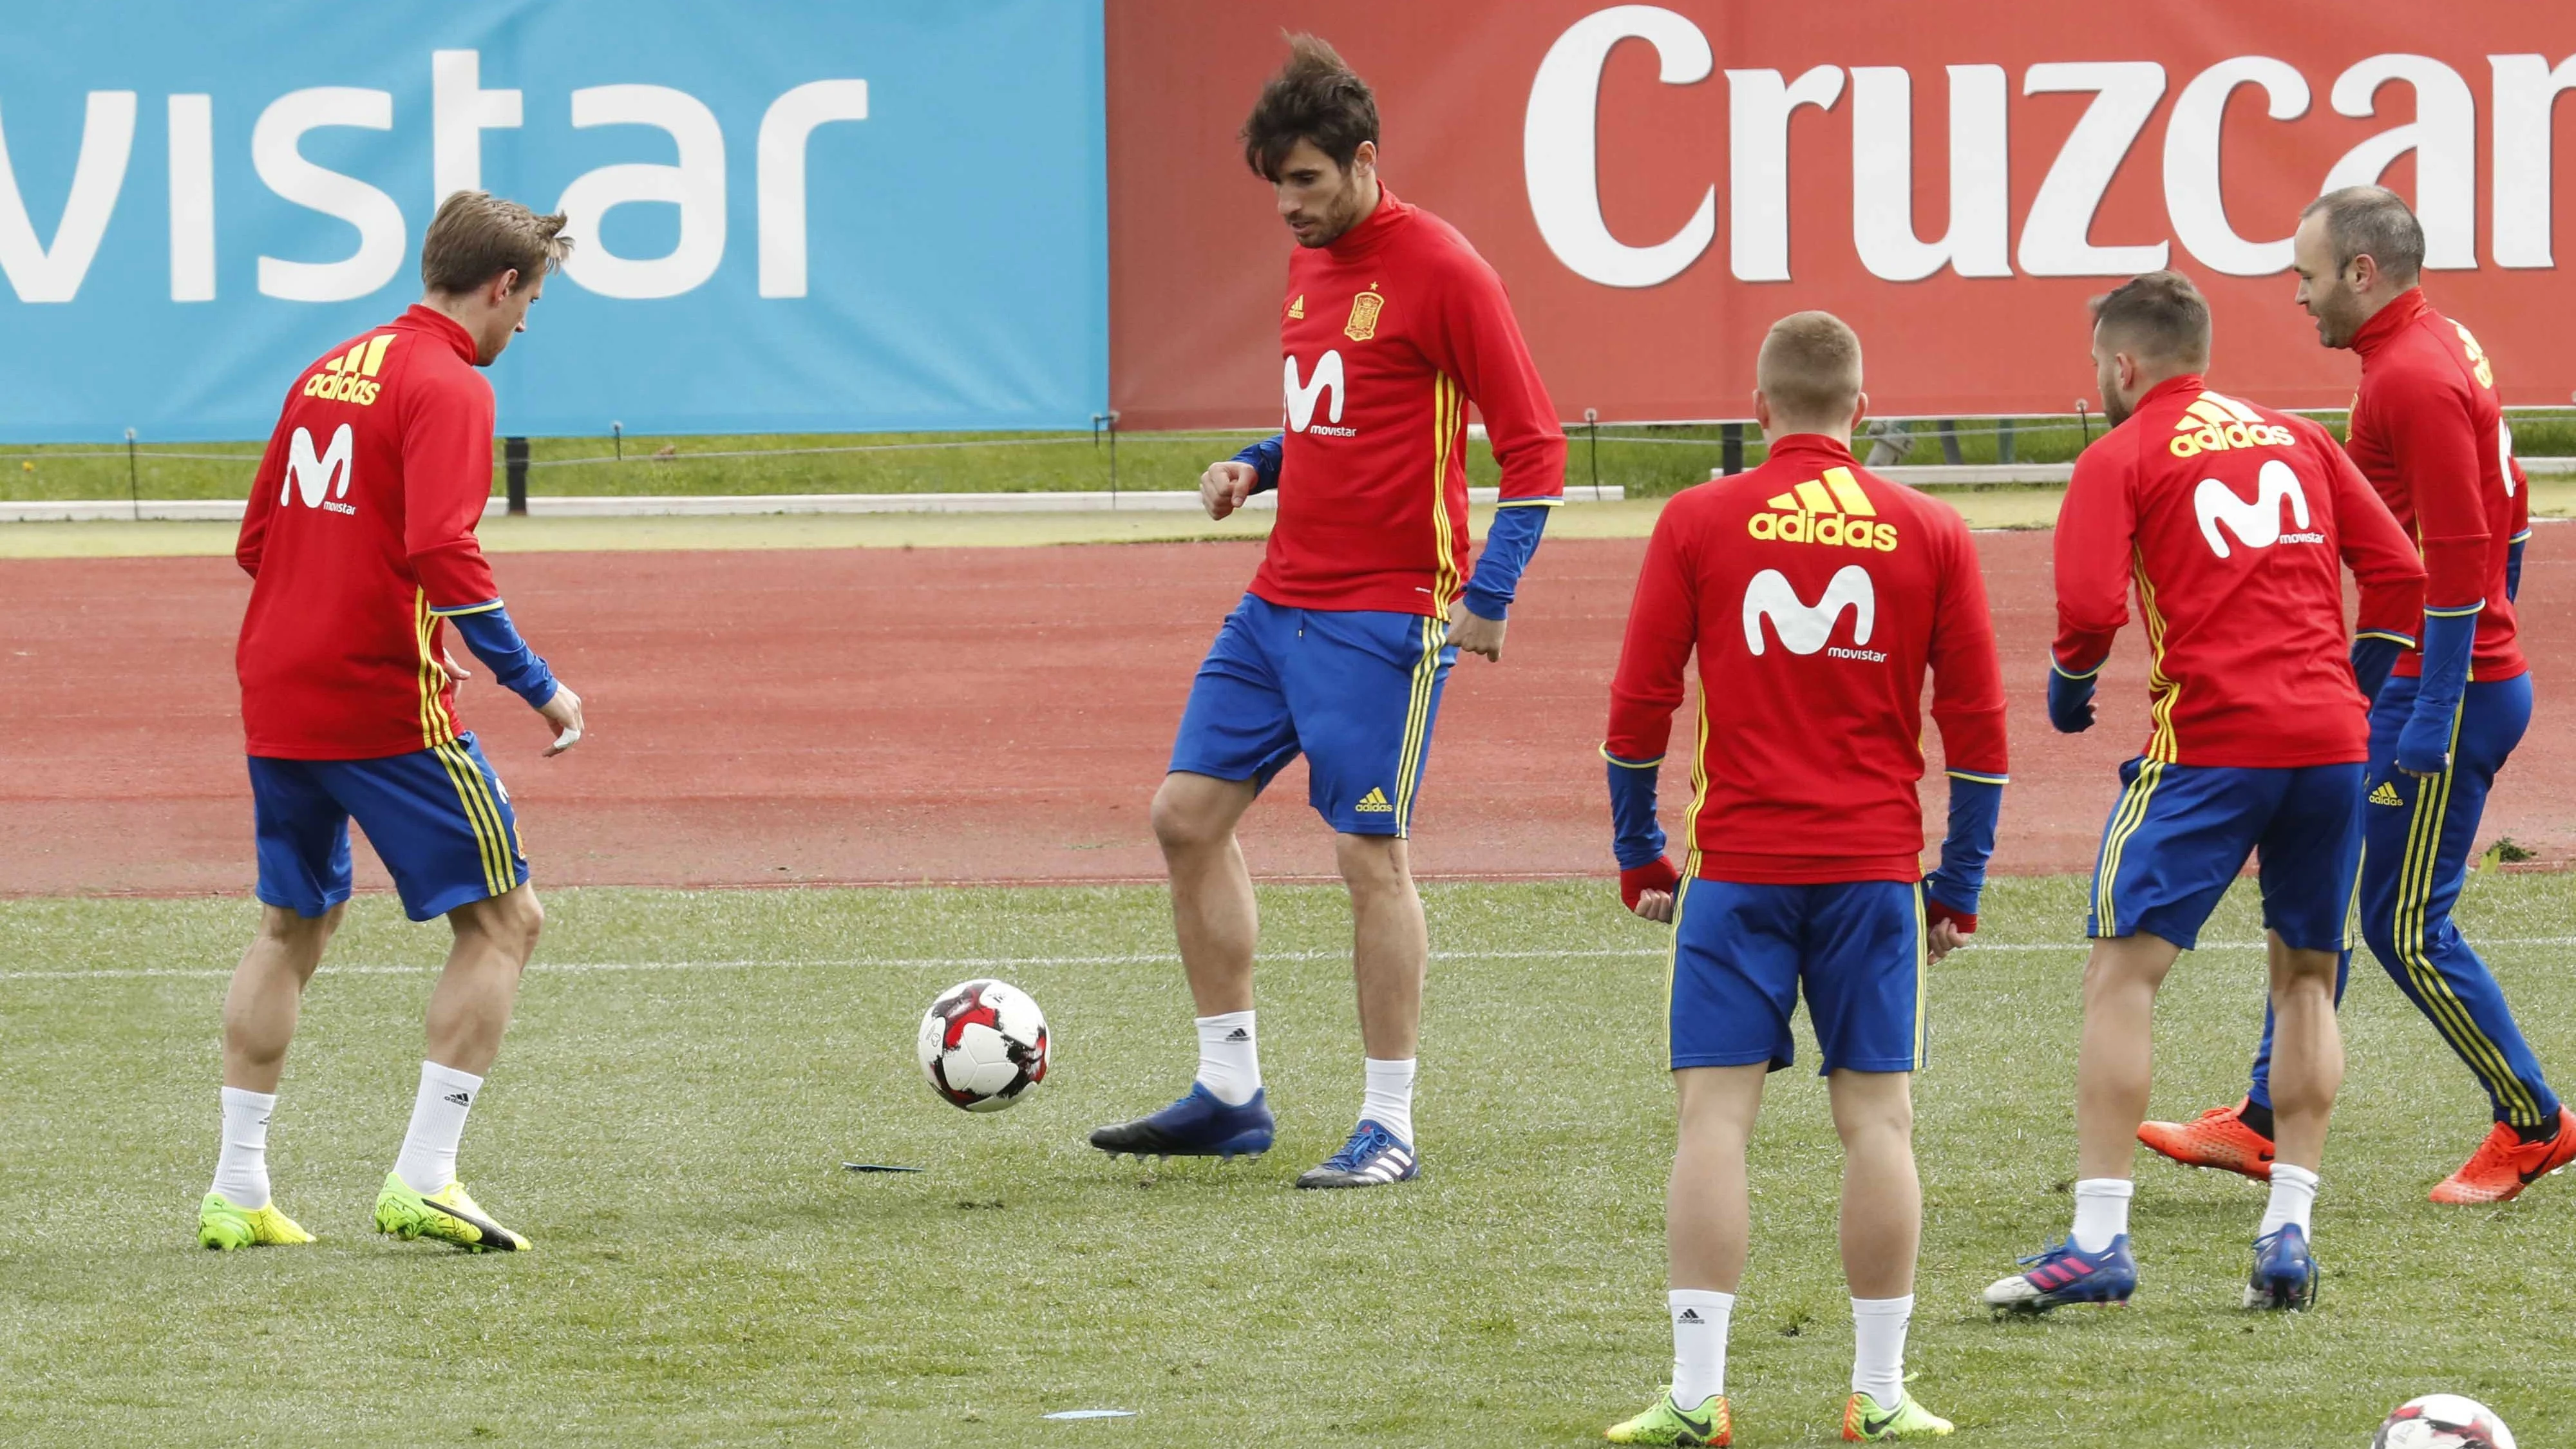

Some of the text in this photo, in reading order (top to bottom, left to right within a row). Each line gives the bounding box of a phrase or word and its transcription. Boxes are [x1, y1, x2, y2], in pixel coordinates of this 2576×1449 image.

[303, 369, 381, 406] adidas
[1310, 424, 1356, 437] movistar
[2170, 421, 2295, 457] adidas
[323, 500, 356, 516] movistar
[1748, 509, 1898, 552] adidas
[2279, 533, 2324, 544] movistar
[1828, 646, 1887, 663] movistar
[1355, 803, 1393, 812] adidas
[2369, 795, 2404, 806] adidas
